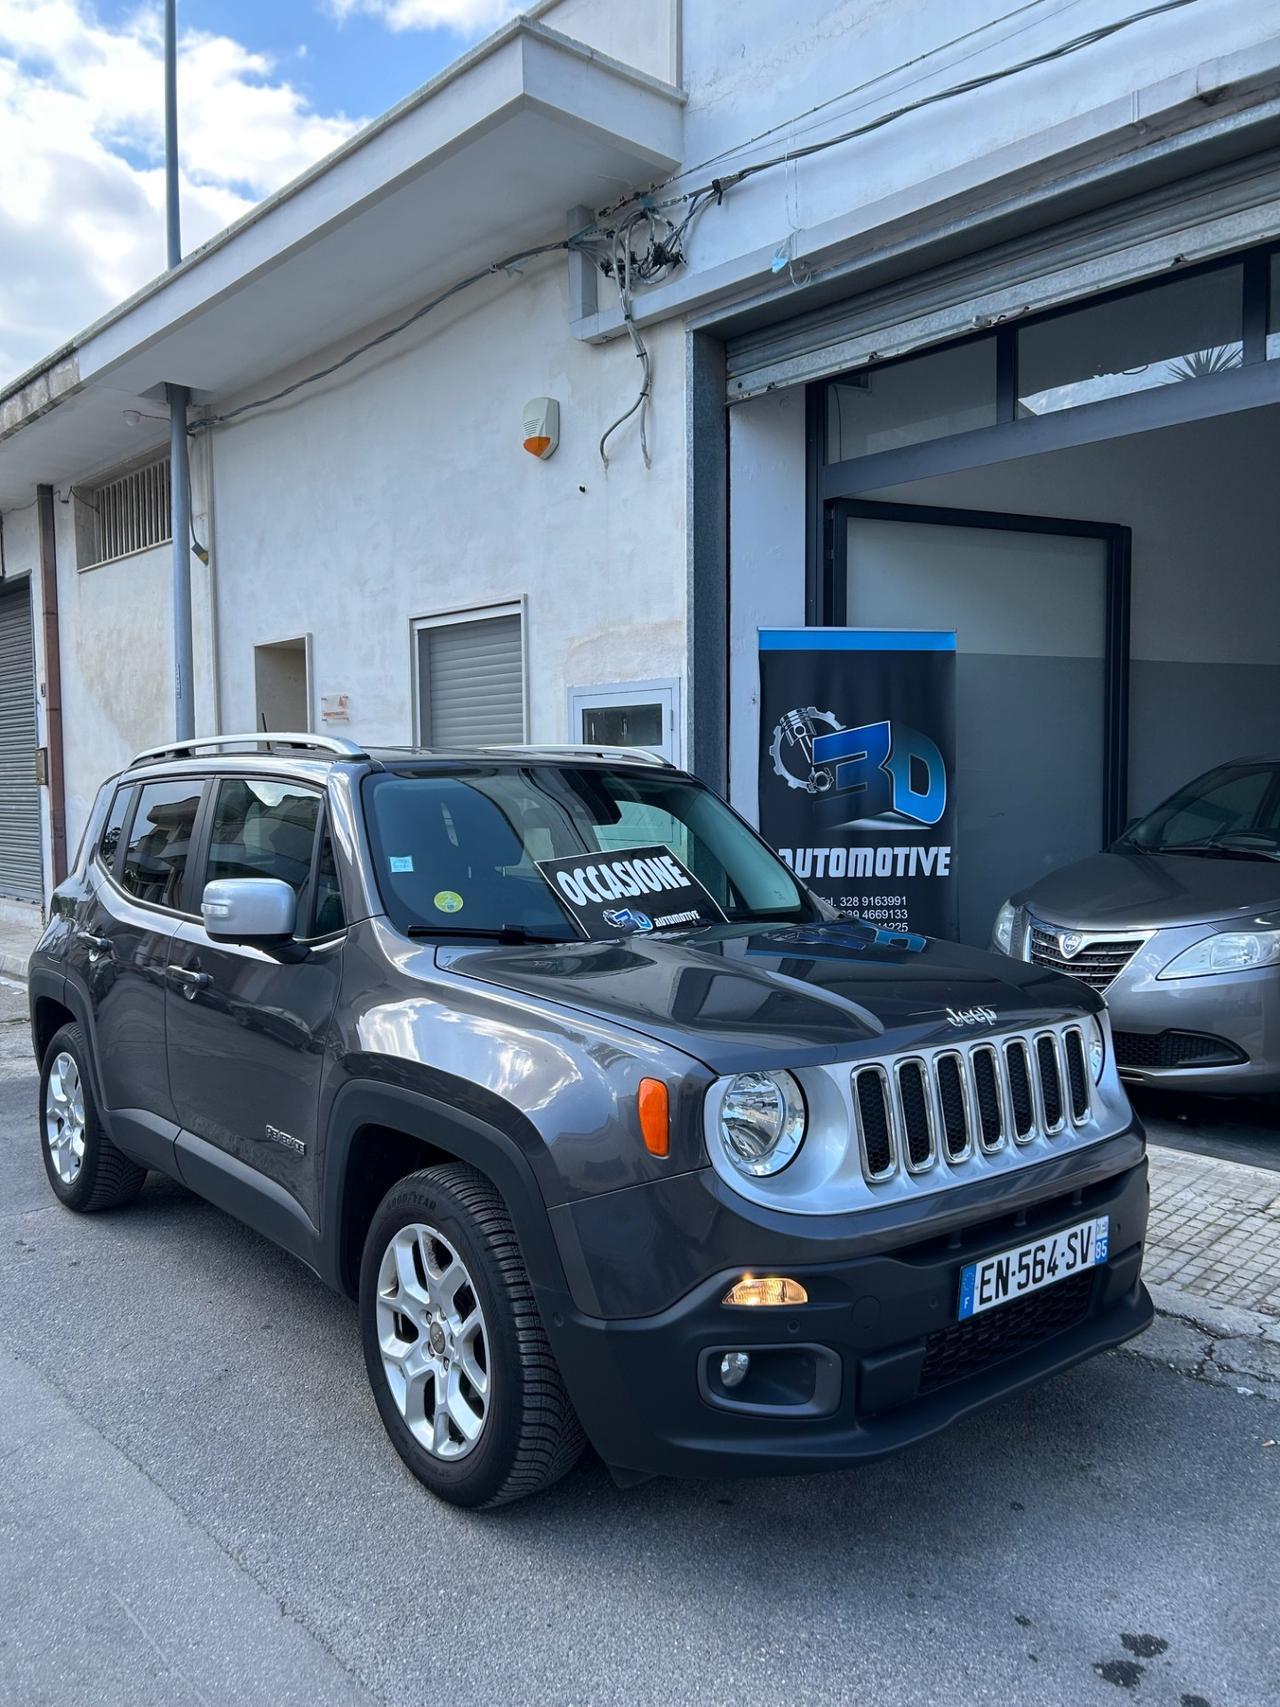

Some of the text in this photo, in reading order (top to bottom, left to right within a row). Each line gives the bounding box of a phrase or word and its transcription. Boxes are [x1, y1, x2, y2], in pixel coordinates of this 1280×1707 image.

[556, 855, 692, 907] OCCASIONE
[840, 896, 859, 907] 328
[862, 896, 907, 906] 9163991
[862, 909, 908, 919] 4669133
[945, 1007, 997, 1027] Jeep
